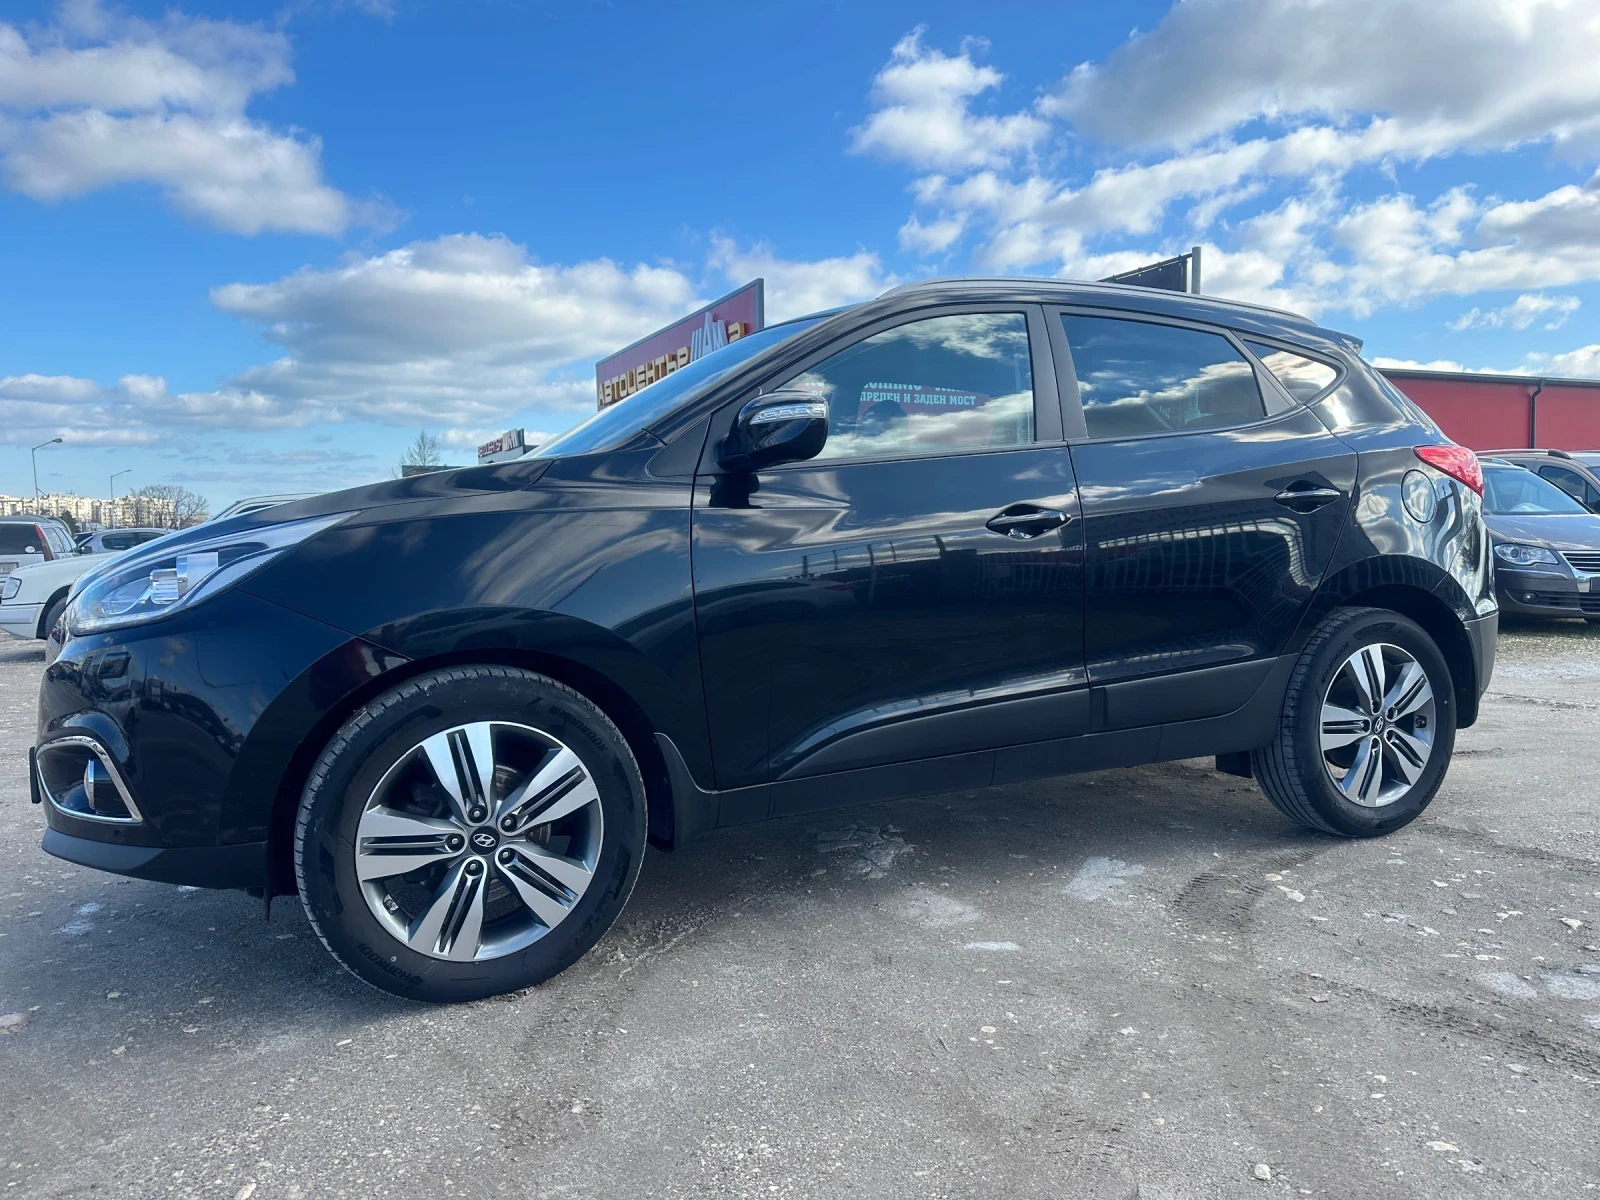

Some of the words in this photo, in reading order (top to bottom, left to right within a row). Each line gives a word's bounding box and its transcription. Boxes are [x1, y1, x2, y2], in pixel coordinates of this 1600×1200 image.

[598, 345, 692, 405] АВТОЦЕНТЪР
[903, 394, 911, 403] И
[914, 393, 946, 405] ЗАДЕН
[949, 395, 977, 406] МОСТ
